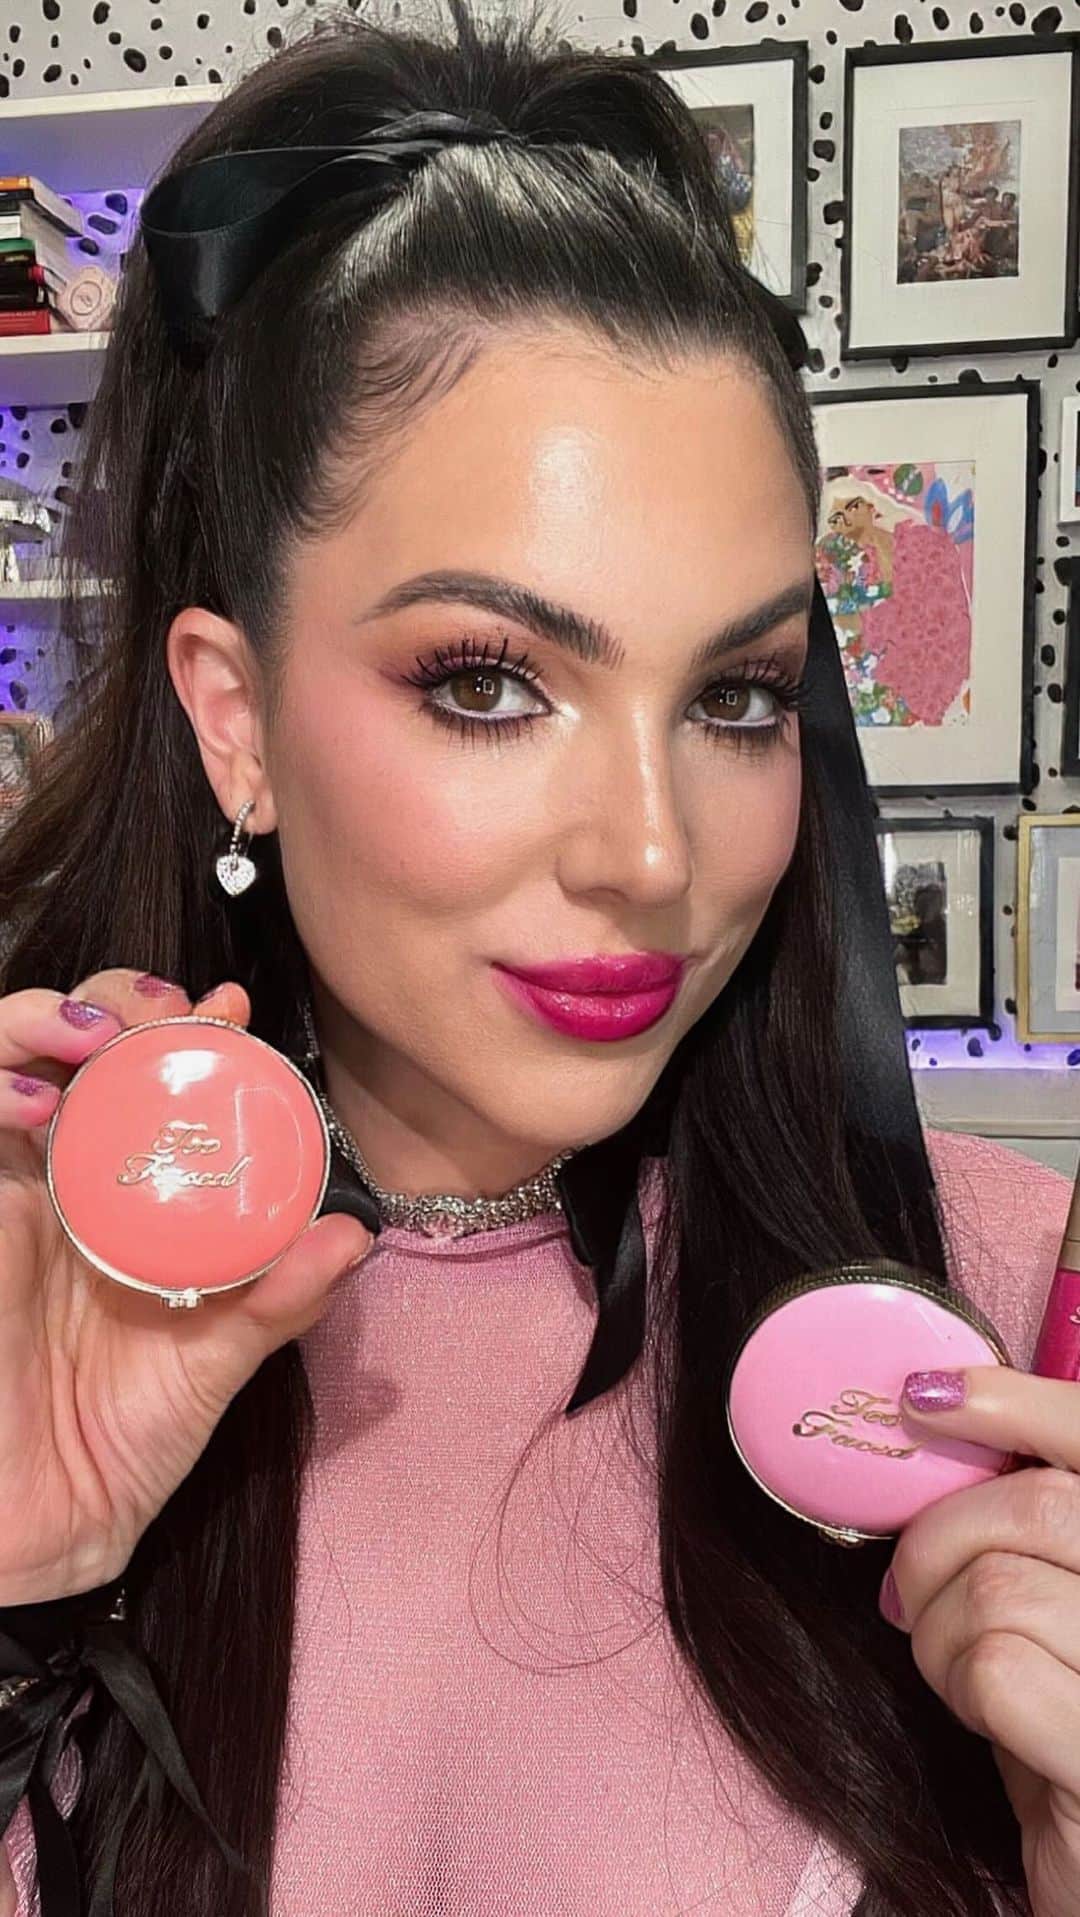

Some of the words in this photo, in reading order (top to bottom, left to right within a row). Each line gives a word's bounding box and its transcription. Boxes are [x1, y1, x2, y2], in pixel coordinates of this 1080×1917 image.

[152, 1119, 221, 1154] Too
[117, 1152, 252, 1188] Fced
[830, 1389, 902, 1426] Too
[792, 1410, 928, 1460] Faced
